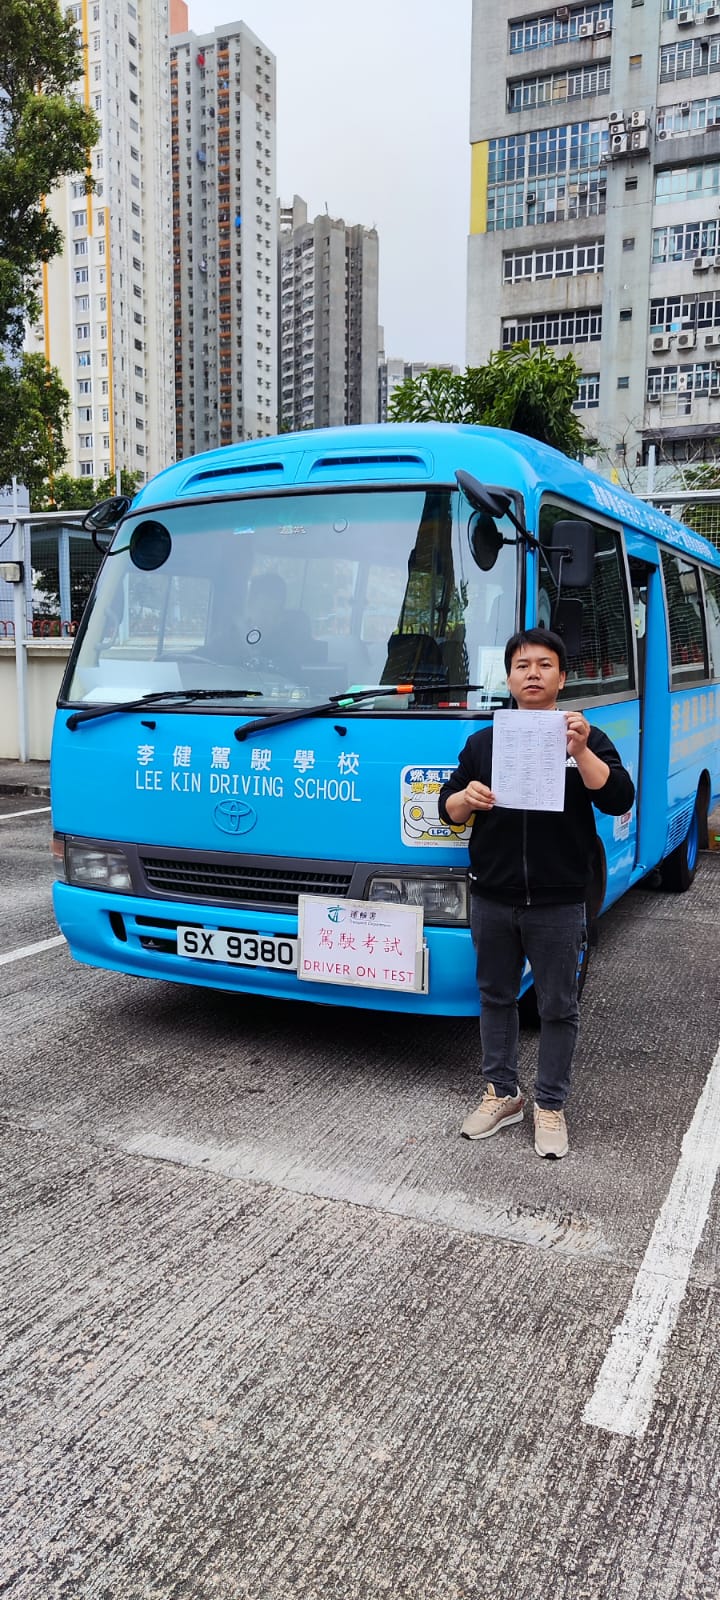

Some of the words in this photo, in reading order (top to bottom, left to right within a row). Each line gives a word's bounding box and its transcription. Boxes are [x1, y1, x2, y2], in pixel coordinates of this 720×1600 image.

[137, 744, 360, 776] 李健駕駛學校
[135, 770, 163, 791] LEE
[171, 772, 201, 793] KIN
[209, 774, 284, 798] DRIVING
[294, 778, 361, 803] SCHOOL
[183, 931, 214, 956] SX
[226, 936, 293, 965] 9380
[318, 927, 403, 957] 駕駛考試
[303, 959, 350, 975] DRIVER
[356, 966, 377, 979] ON
[383, 969, 415, 983] TEST
